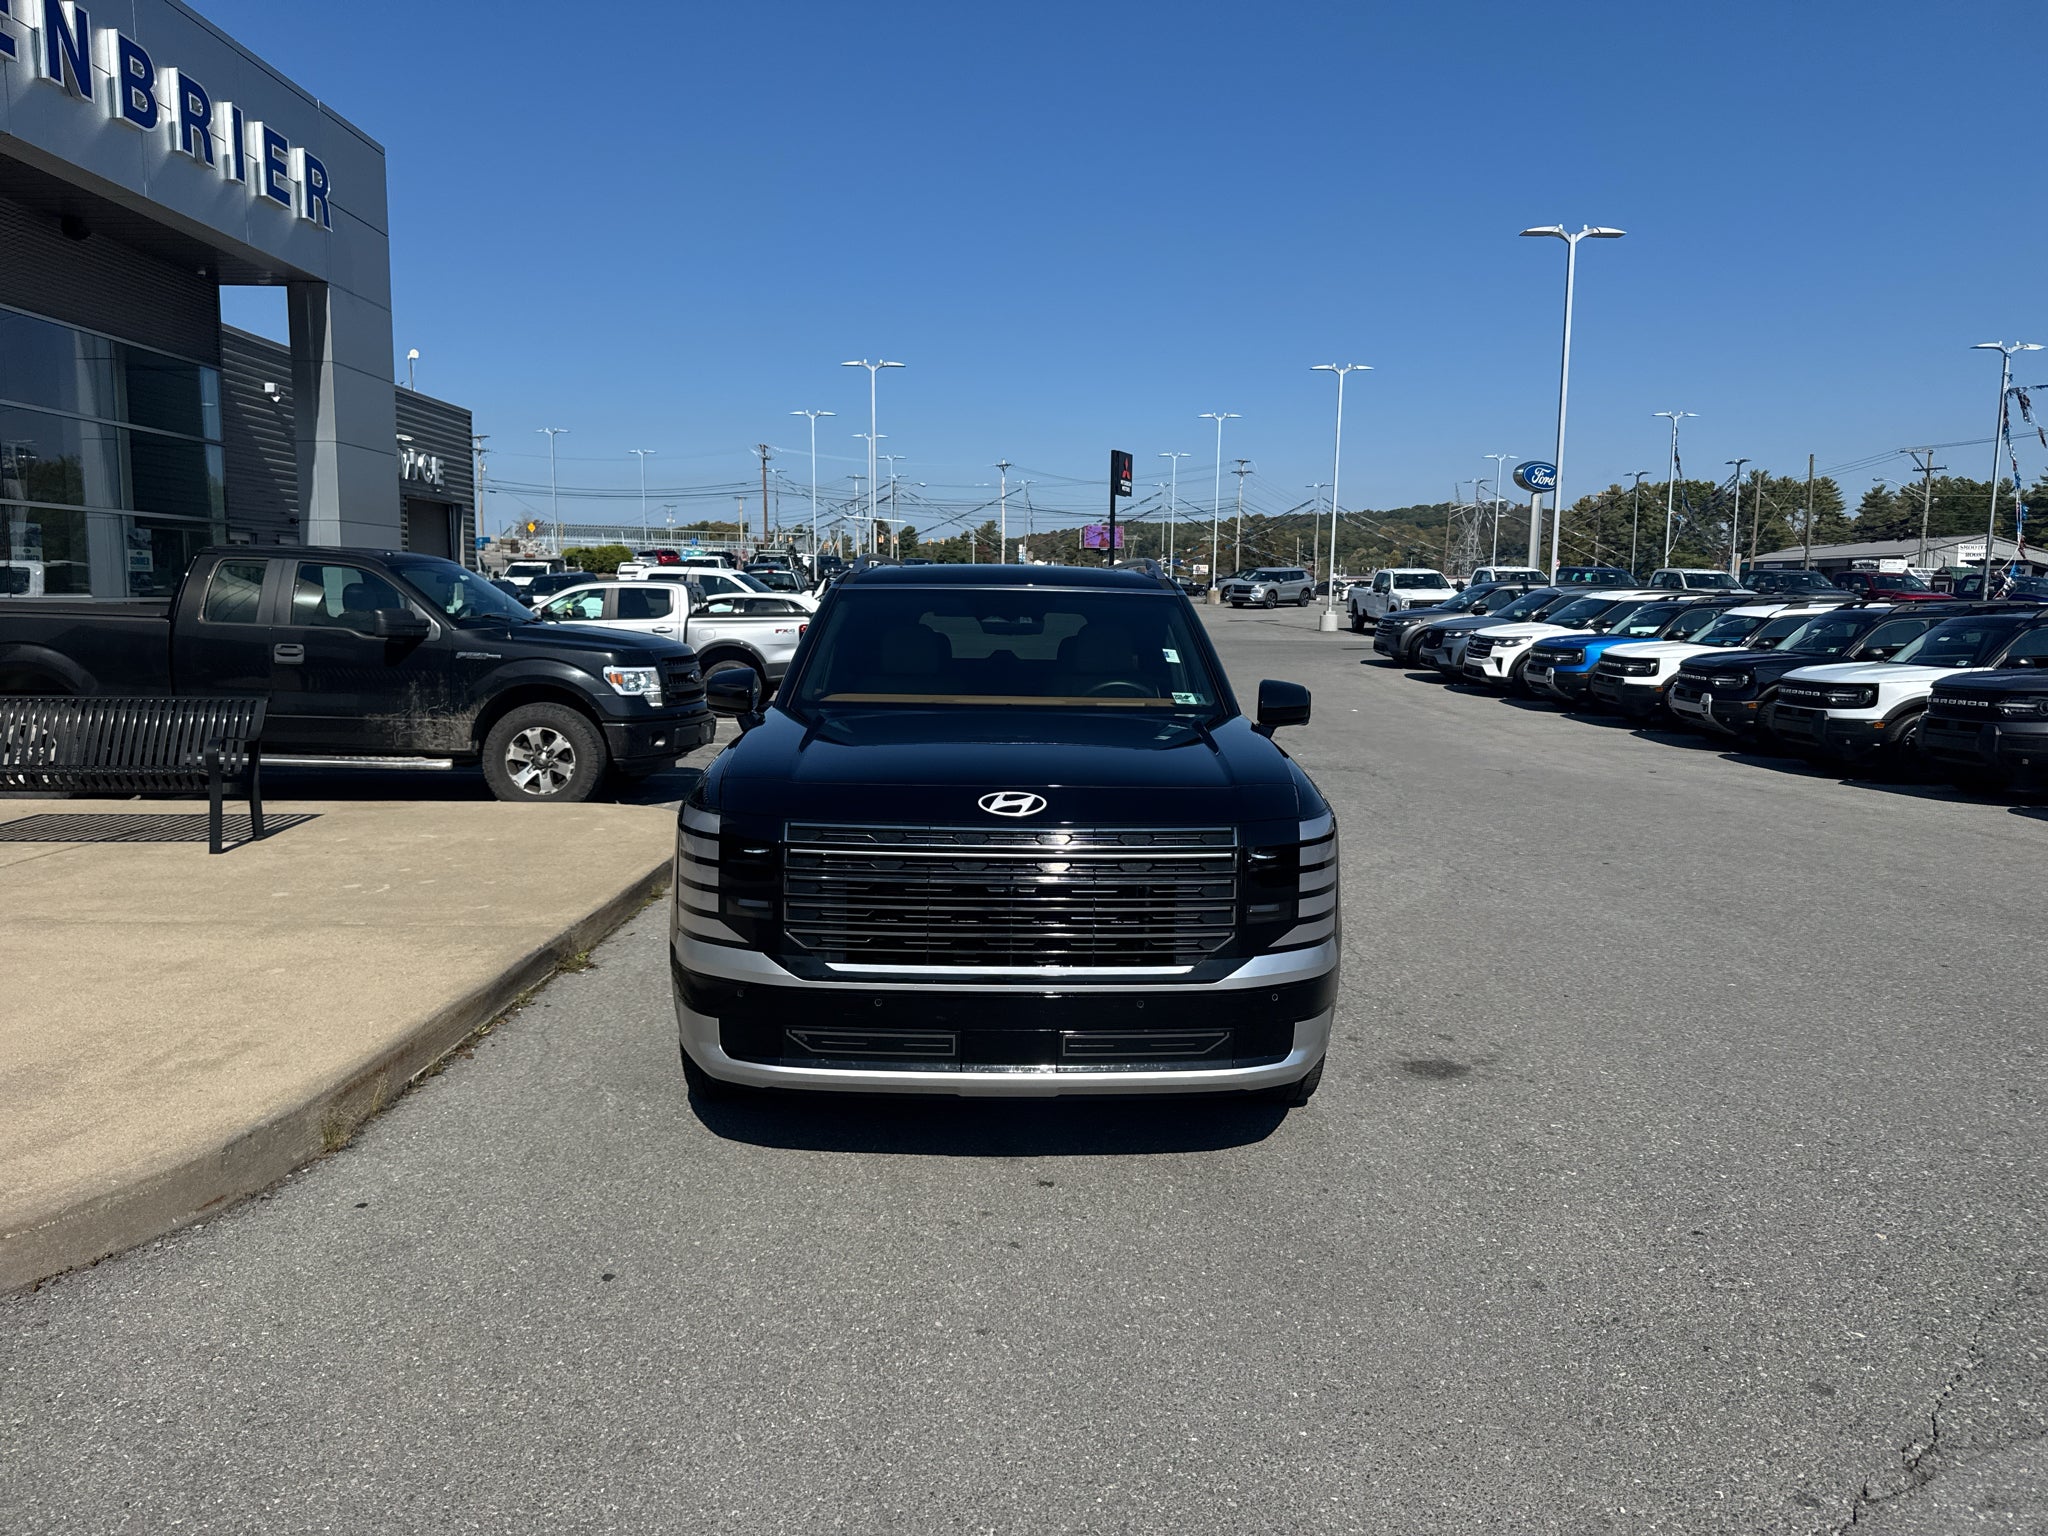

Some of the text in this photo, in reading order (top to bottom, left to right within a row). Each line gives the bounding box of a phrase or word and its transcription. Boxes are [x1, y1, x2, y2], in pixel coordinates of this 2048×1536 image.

[0, 0, 333, 232] NBRIER
[1532, 467, 1556, 486] Ford
[1781, 687, 1820, 696] BRONCO
[1932, 698, 1988, 707] BRONCO
